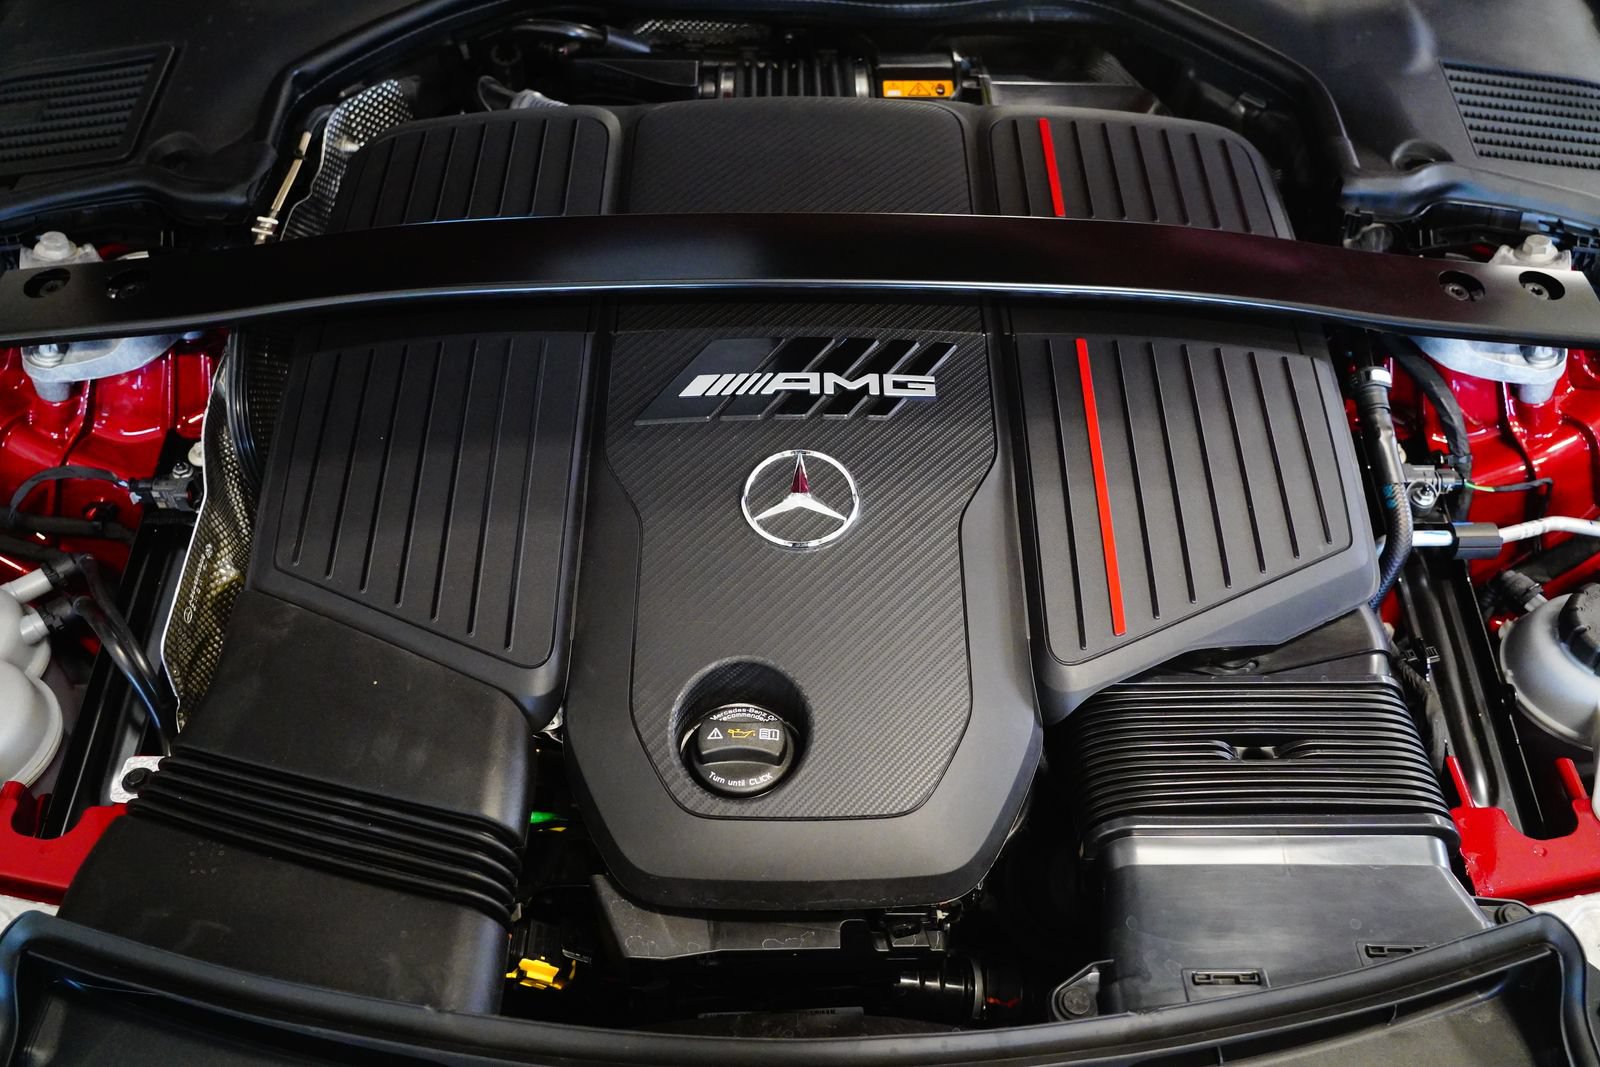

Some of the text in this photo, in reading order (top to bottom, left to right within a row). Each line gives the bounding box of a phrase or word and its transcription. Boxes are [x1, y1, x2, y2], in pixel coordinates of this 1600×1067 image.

[760, 371, 937, 397] AMG
[709, 771, 774, 787] Turn until CLICK
